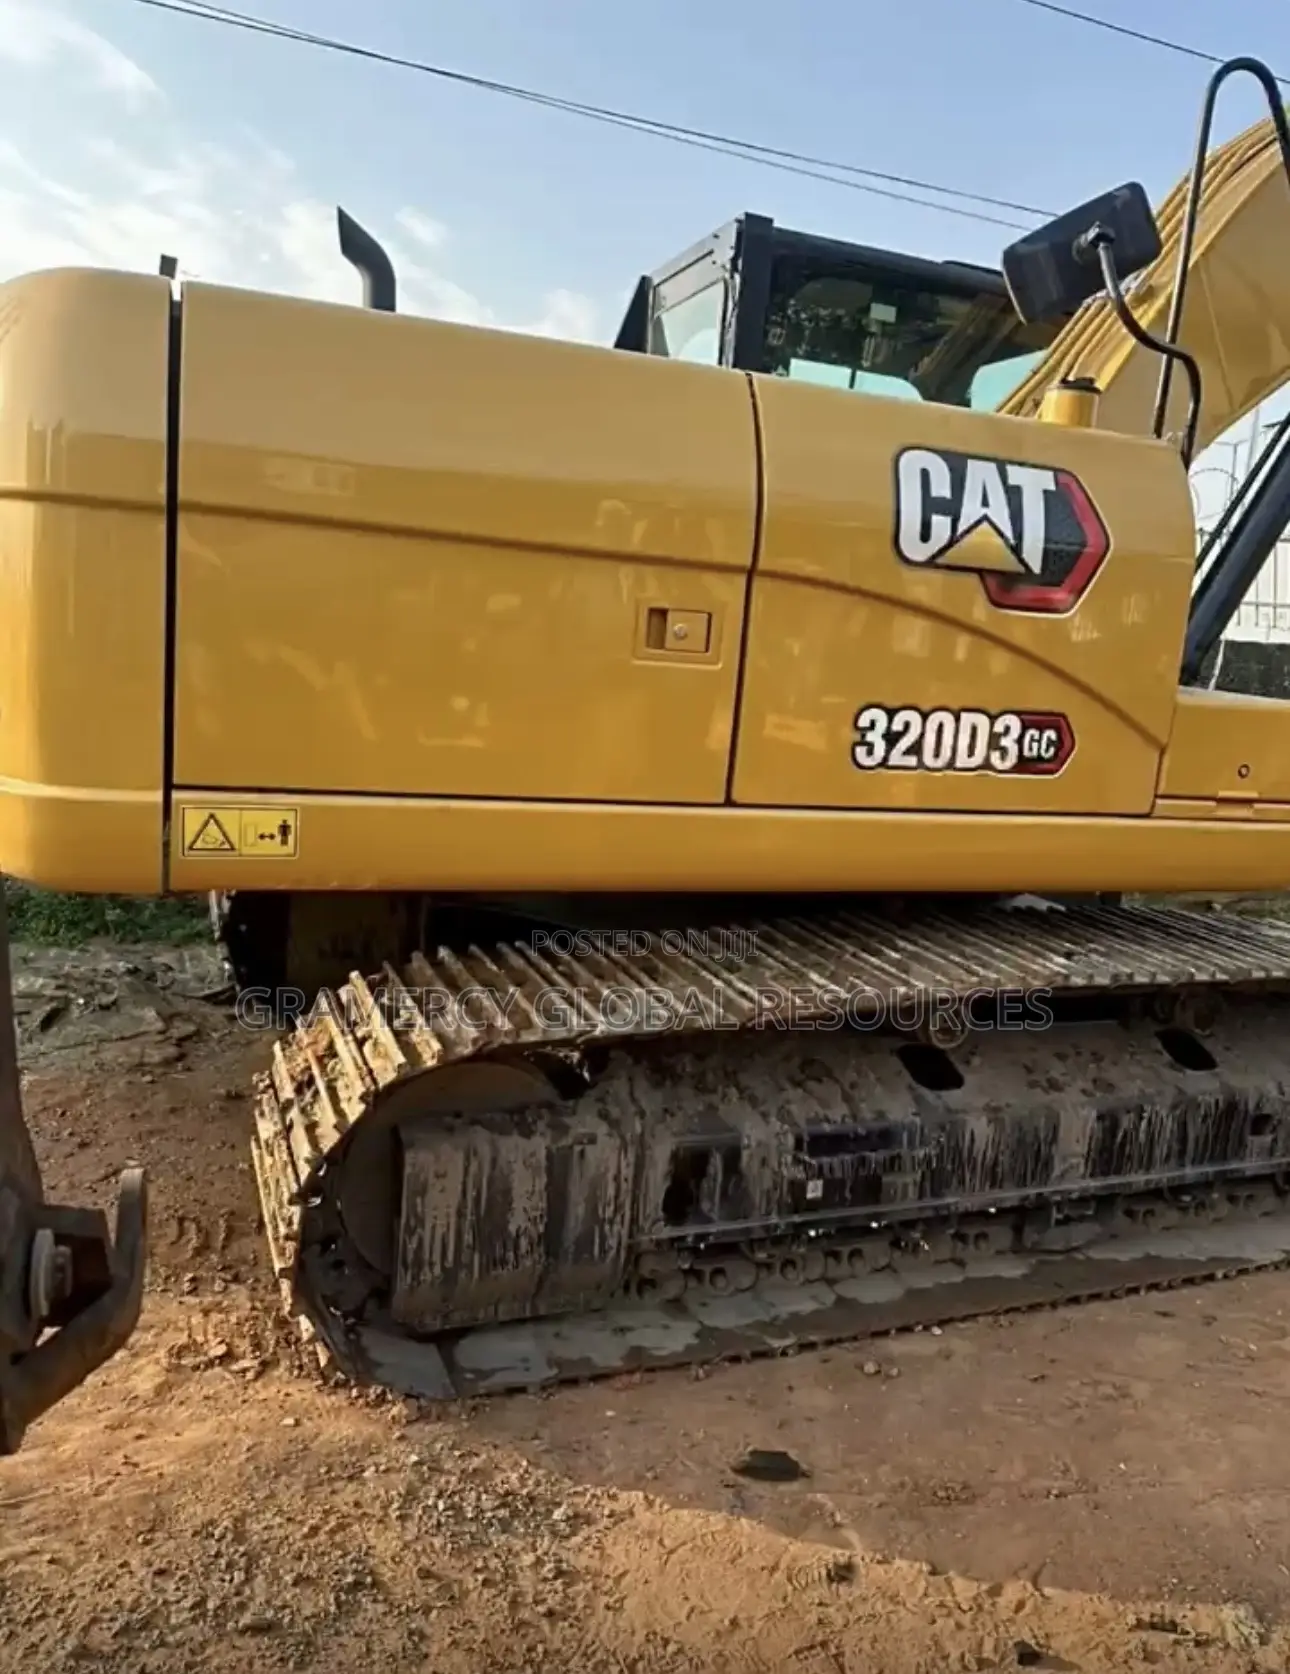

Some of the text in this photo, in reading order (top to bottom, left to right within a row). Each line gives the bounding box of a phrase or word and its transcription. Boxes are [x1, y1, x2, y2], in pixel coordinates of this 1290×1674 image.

[898, 448, 1056, 575] CAT
[854, 707, 1057, 770] 320D3 GC
